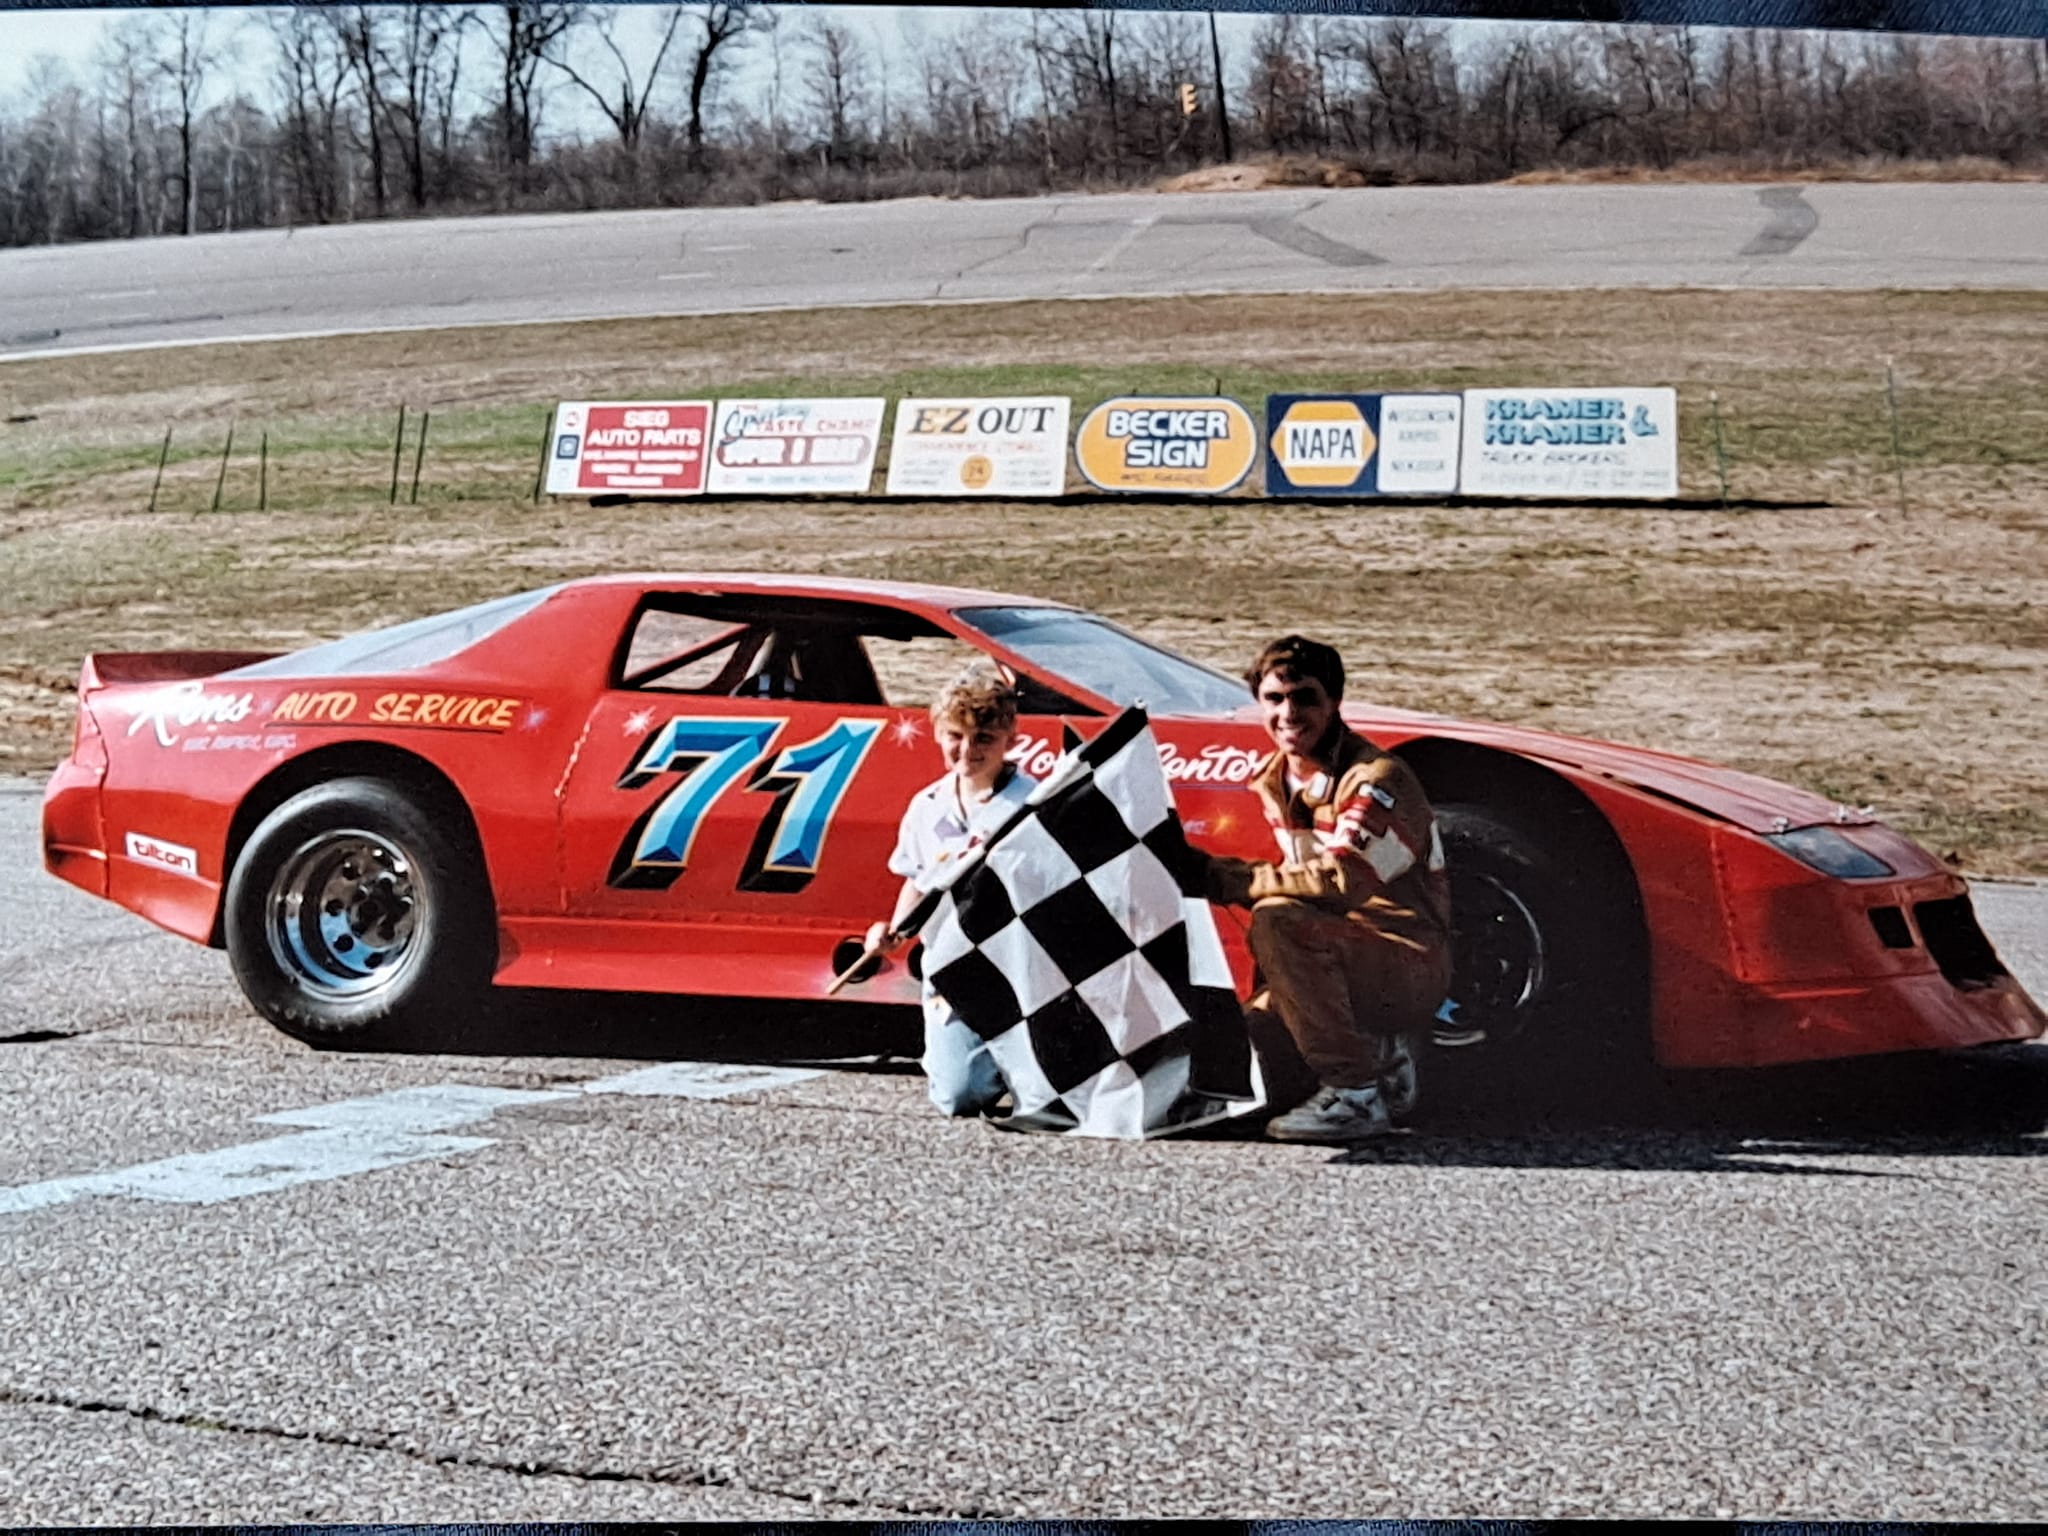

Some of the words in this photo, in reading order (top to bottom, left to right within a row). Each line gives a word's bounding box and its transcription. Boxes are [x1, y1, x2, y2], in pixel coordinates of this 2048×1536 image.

[907, 407, 970, 434] EZ
[977, 407, 1054, 434] OUT
[1108, 411, 1229, 438] BECKER
[1485, 399, 1626, 420] KRAMER
[1630, 405, 1659, 437] &
[587, 428, 641, 446] AUTO
[642, 428, 702, 447] PARTS
[1291, 428, 1356, 459] NAPA
[1484, 424, 1626, 445] KRAMER
[1126, 440, 1208, 467] SIGN
[273, 691, 357, 721] AUTO
[369, 693, 521, 726] SERVICE
[606, 716, 888, 892] 71
